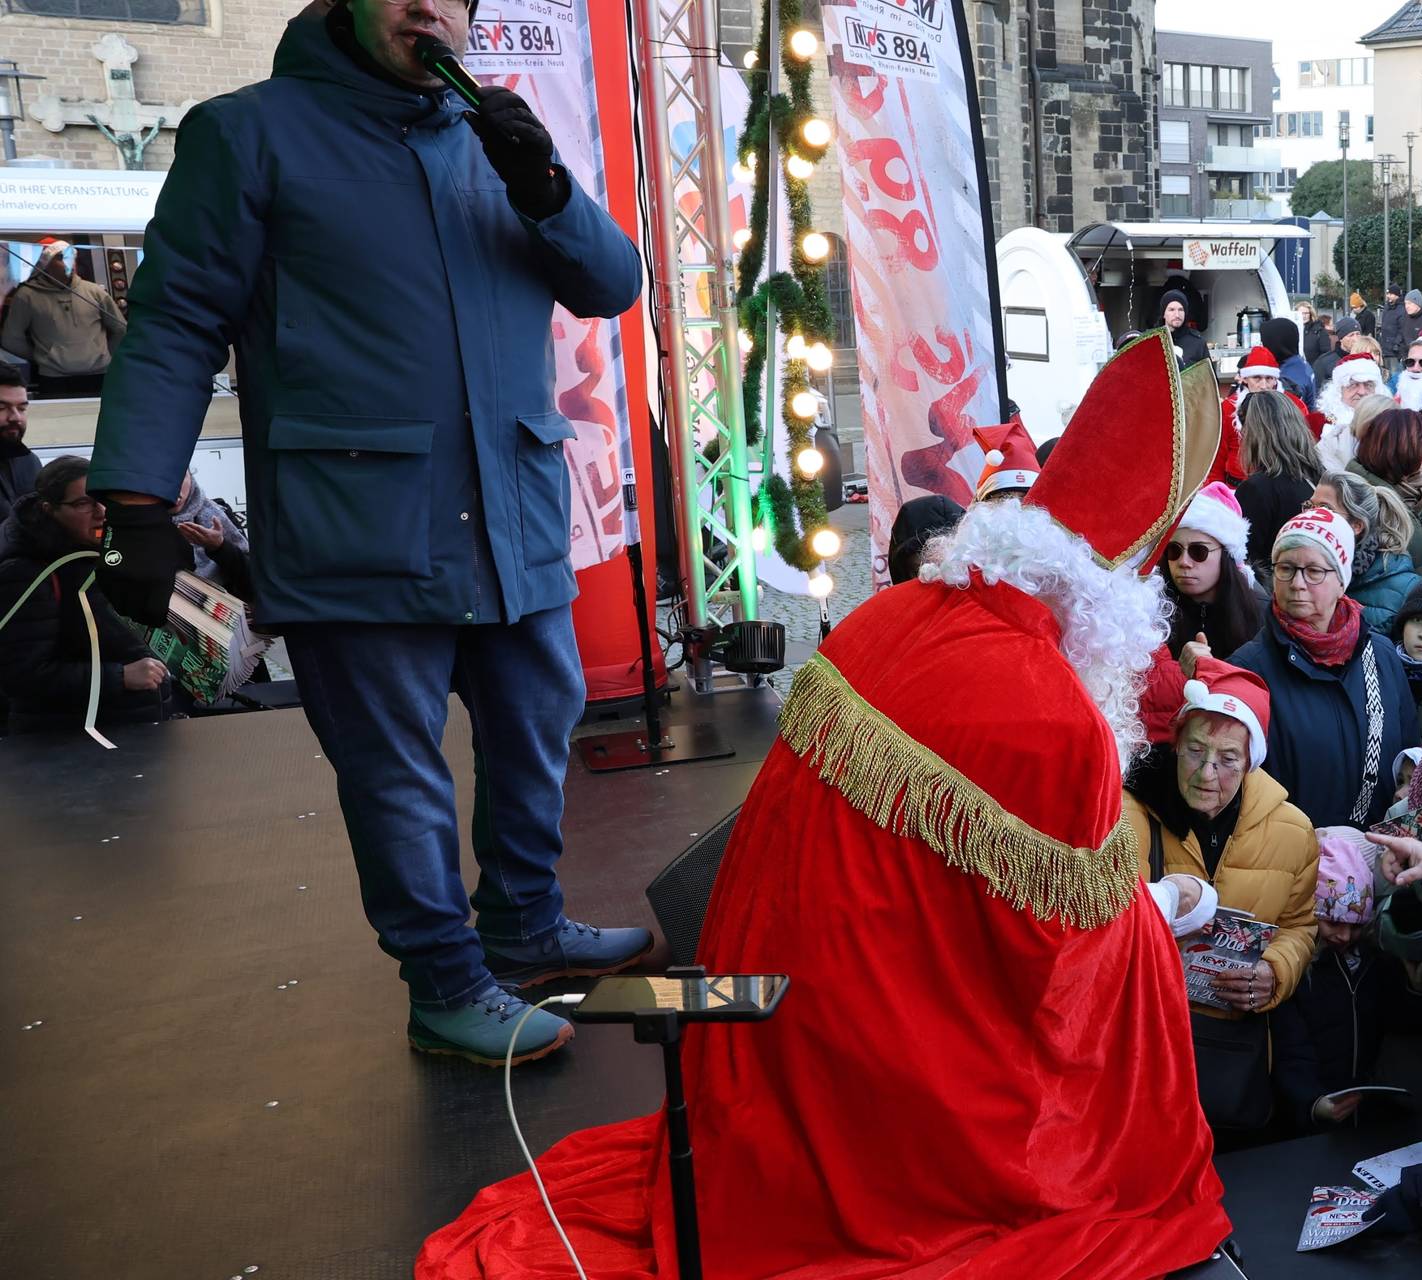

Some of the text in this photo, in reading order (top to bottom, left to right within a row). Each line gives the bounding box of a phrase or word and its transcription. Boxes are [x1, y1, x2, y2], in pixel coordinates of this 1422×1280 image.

[19, 184, 48, 195] IHRE
[50, 184, 150, 197] VERANSTALTUNG
[1210, 242, 1257, 256] Waffeln
